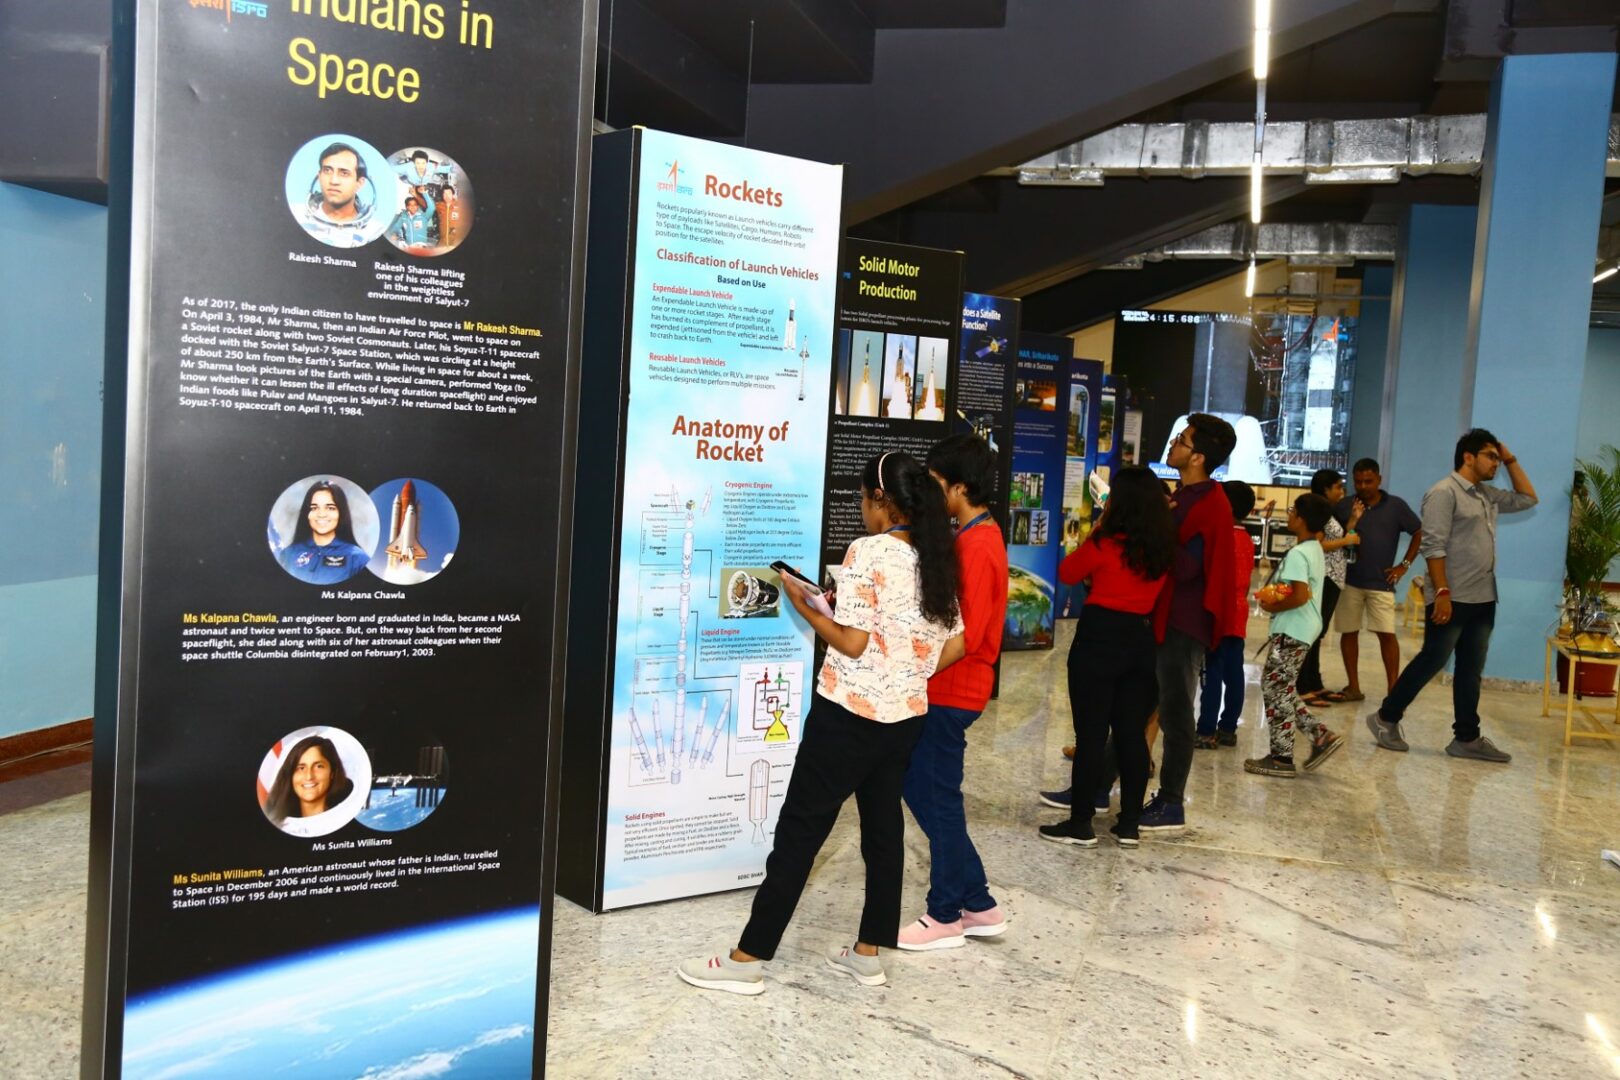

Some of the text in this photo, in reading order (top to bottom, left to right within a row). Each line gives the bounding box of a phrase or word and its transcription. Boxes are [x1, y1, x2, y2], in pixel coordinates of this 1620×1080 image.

[460, 0, 494, 49] in
[288, 38, 420, 103] Space
[705, 174, 783, 208] Rockets
[288, 251, 357, 267] Rakesh Sharma
[656, 248, 818, 280] Classification of Launch Vehicles
[859, 256, 920, 277] Solid Motor
[374, 261, 465, 281] Rakesh Sharma lifting
[375, 272, 463, 288] one of his colleagues
[717, 274, 740, 285] Based
[752, 279, 766, 288] Use
[383, 281, 454, 297] in the weightless
[652, 283, 733, 300] Expendable Launch Vehicle
[859, 280, 916, 300] Production
[368, 290, 402, 302] environment
[435, 296, 469, 307] Salyut-7
[181, 296, 542, 336] As of 2017, the only Indian citizen to have travelled to space is Mr Rakesh Sharma.
[963, 307, 976, 318] does
[980, 309, 1001, 321] Satellite
[181, 309, 197, 318] On
[199, 310, 223, 321] April
[225, 312, 234, 322] 3,
[238, 313, 264, 325] 1984,
[267, 316, 281, 325] Mr
[283, 317, 320, 330] Sharma,
[322, 321, 343, 331] then
[358, 324, 386, 334] Indian
[388, 327, 401, 335] Air
[403, 328, 426, 338] Force
[428, 330, 449, 341] Pilot,
[474, 335, 484, 343] to
[486, 337, 508, 346] space
[962, 319, 987, 331] Function?
[650, 352, 726, 367] Reusable Launch Vehicles
[179, 396, 232, 408] Soyuz-T-10
[233, 401, 281, 411] spacecraft
[297, 404, 320, 414] April
[322, 405, 336, 415] 11,
[339, 406, 364, 416] 1984.
[672, 415, 789, 444] Anatomy of
[696, 439, 763, 462] Rocket
[725, 481, 772, 491] Cryogenic Engine
[321, 590, 405, 600] Ms Kalpana Chawla
[183, 613, 198, 623] Ms
[200, 613, 239, 625] Kalpana
[241, 612, 279, 623] Chawla,
[295, 614, 334, 624] engineer
[336, 614, 356, 622] born
[358, 614, 375, 622] and
[377, 614, 420, 624] graduated
[432, 613, 455, 623] India,
[457, 614, 488, 622] became
[497, 613, 520, 621] NASA
[702, 628, 740, 637] Liquid Engine
[181, 652, 208, 662] space
[210, 650, 243, 659] shuttle
[245, 649, 288, 658] Columbia
[290, 648, 349, 659] disintegrated
[412, 647, 435, 656] 2003.
[642, 811, 665, 820] Engines
[312, 838, 392, 850] Ms Sunita Williams
[173, 874, 188, 884] Ms
[190, 871, 221, 883] Sunita
[222, 868, 265, 879] Williams,
[281, 864, 323, 874] American
[325, 860, 366, 871] astronaut
[368, 858, 395, 867] whose
[397, 856, 423, 864] father
[433, 853, 461, 862] Indian,
[463, 849, 498, 859] travelled
[172, 898, 206, 908] Station
[208, 895, 229, 905] (ISS)
[231, 894, 245, 902] for
[248, 891, 265, 900] 195
[267, 890, 288, 900] days
[290, 887, 307, 897] and
[309, 885, 333, 894] made
[343, 882, 368, 891] world
[370, 879, 399, 889] record.
